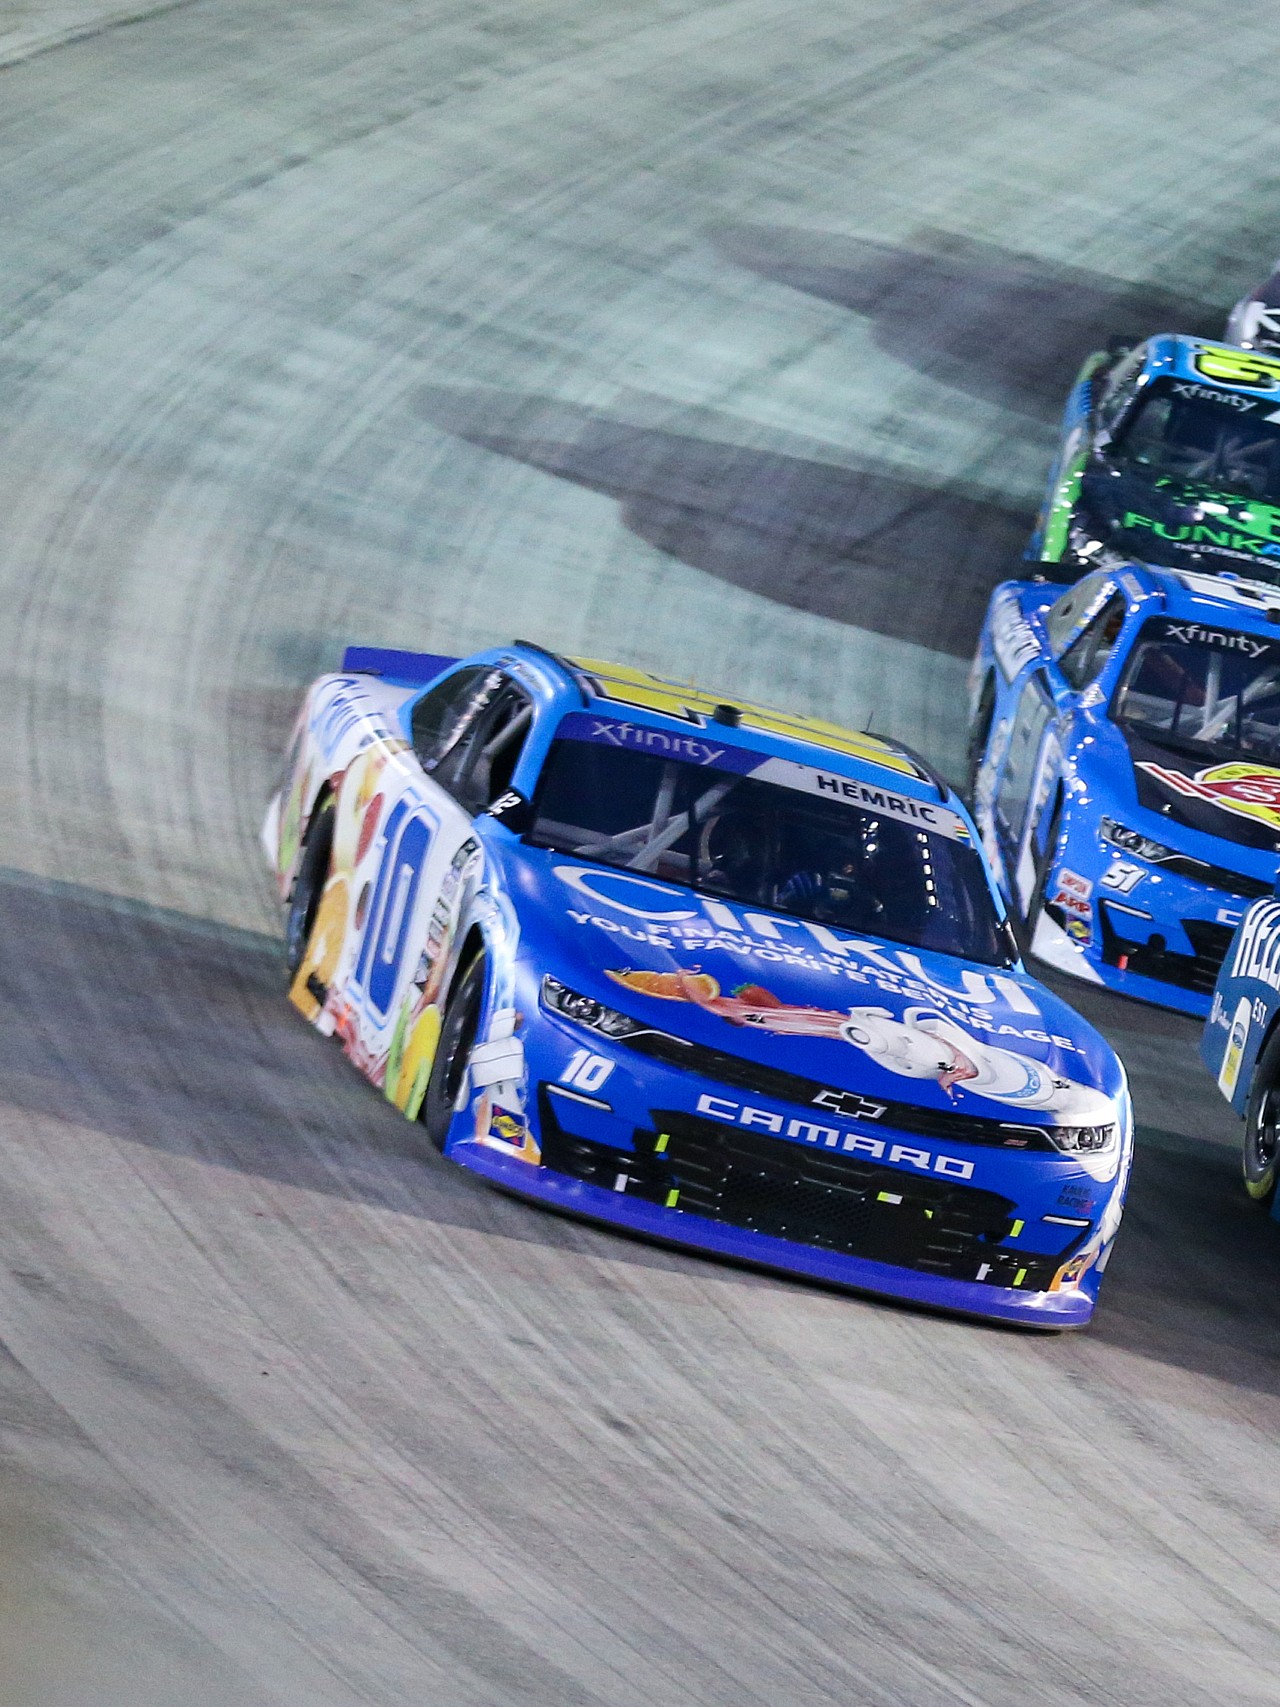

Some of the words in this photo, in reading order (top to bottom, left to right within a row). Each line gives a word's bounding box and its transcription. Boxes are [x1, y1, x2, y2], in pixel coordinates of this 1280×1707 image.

[1170, 381, 1259, 412] xfinity
[1165, 624, 1271, 659] xfinity
[591, 720, 727, 766] xfinity
[816, 774, 938, 825] HEMRIC
[1101, 860, 1149, 894] 51
[566, 908, 676, 950] YOUR
[681, 932, 871, 985] FAVORITE
[875, 977, 1087, 1055] BEVERAGE.
[643, 921, 813, 960] FINALLY,
[819, 952, 952, 1007] WATER
[958, 1001, 994, 1021] IS
[559, 1049, 617, 1093] 10
[696, 1093, 976, 1180] CAMARO
